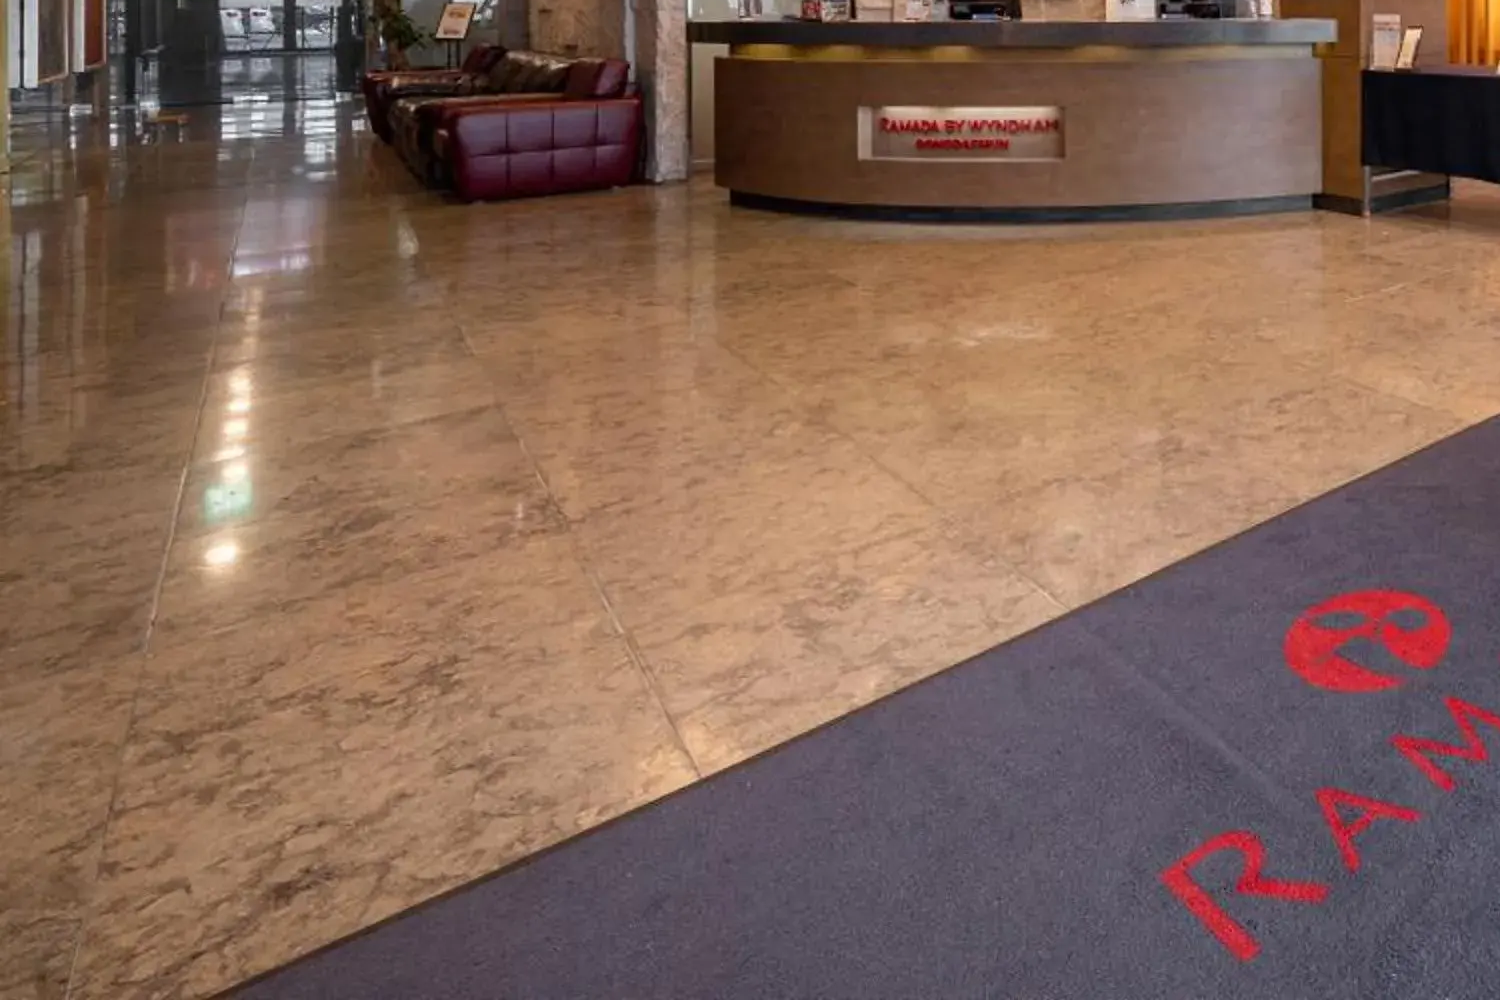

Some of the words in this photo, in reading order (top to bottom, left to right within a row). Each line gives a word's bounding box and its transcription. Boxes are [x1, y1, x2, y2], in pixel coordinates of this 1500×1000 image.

[879, 117, 940, 134] RAMADA
[943, 119, 966, 134] BY
[969, 118, 1061, 134] WYNDHAM
